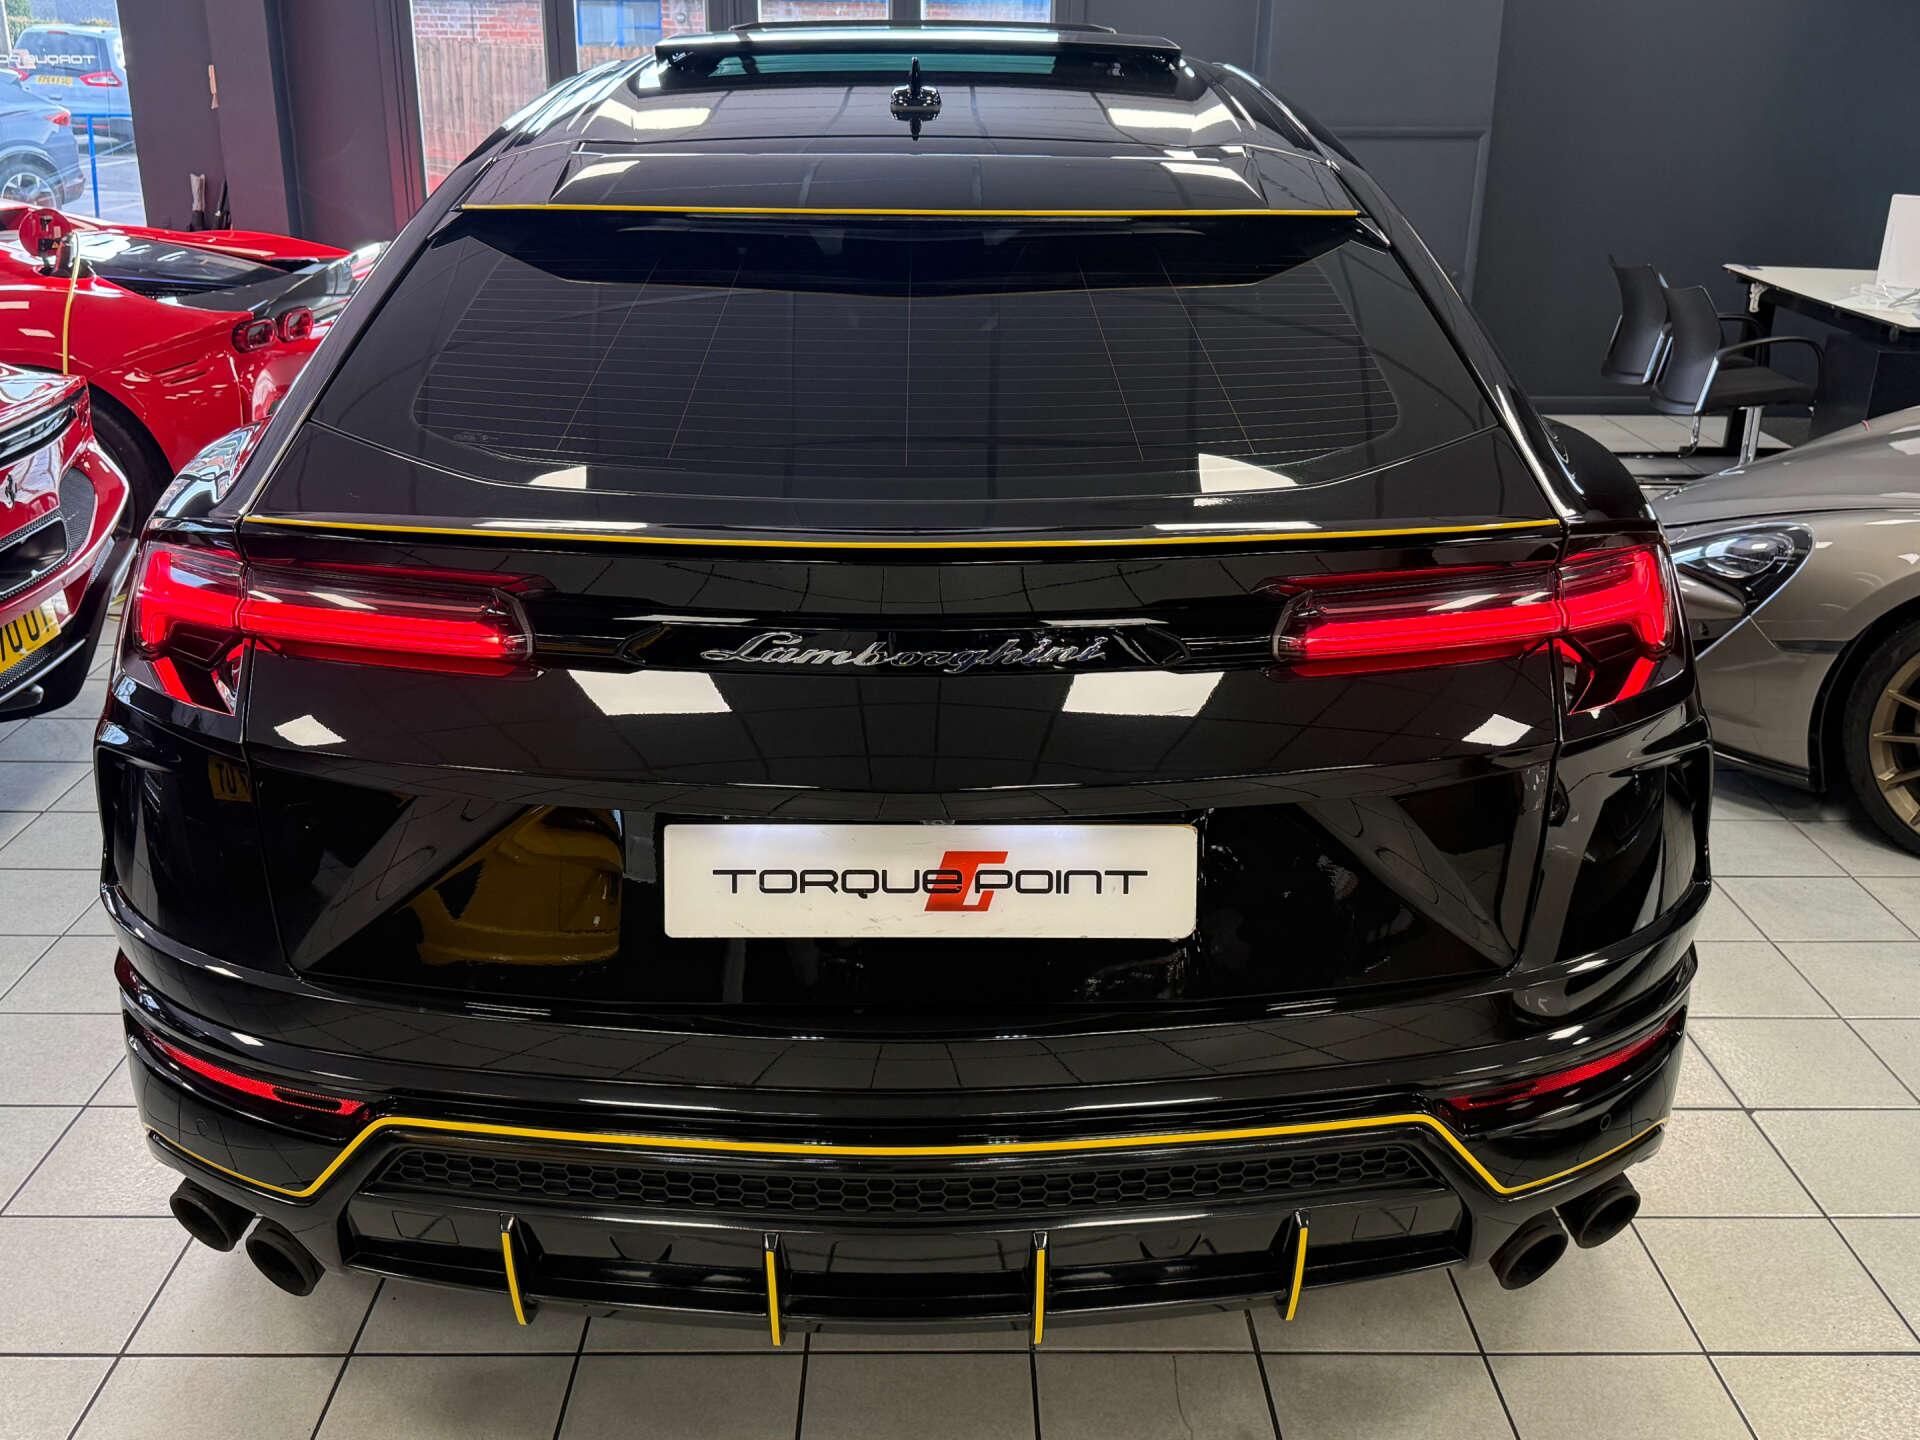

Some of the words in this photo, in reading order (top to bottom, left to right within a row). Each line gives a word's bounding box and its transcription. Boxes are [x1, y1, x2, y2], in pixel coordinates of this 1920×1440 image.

[700, 632, 1107, 674] Lamborghini
[712, 869, 963, 898] TORQUE
[975, 869, 1148, 895] POINT
